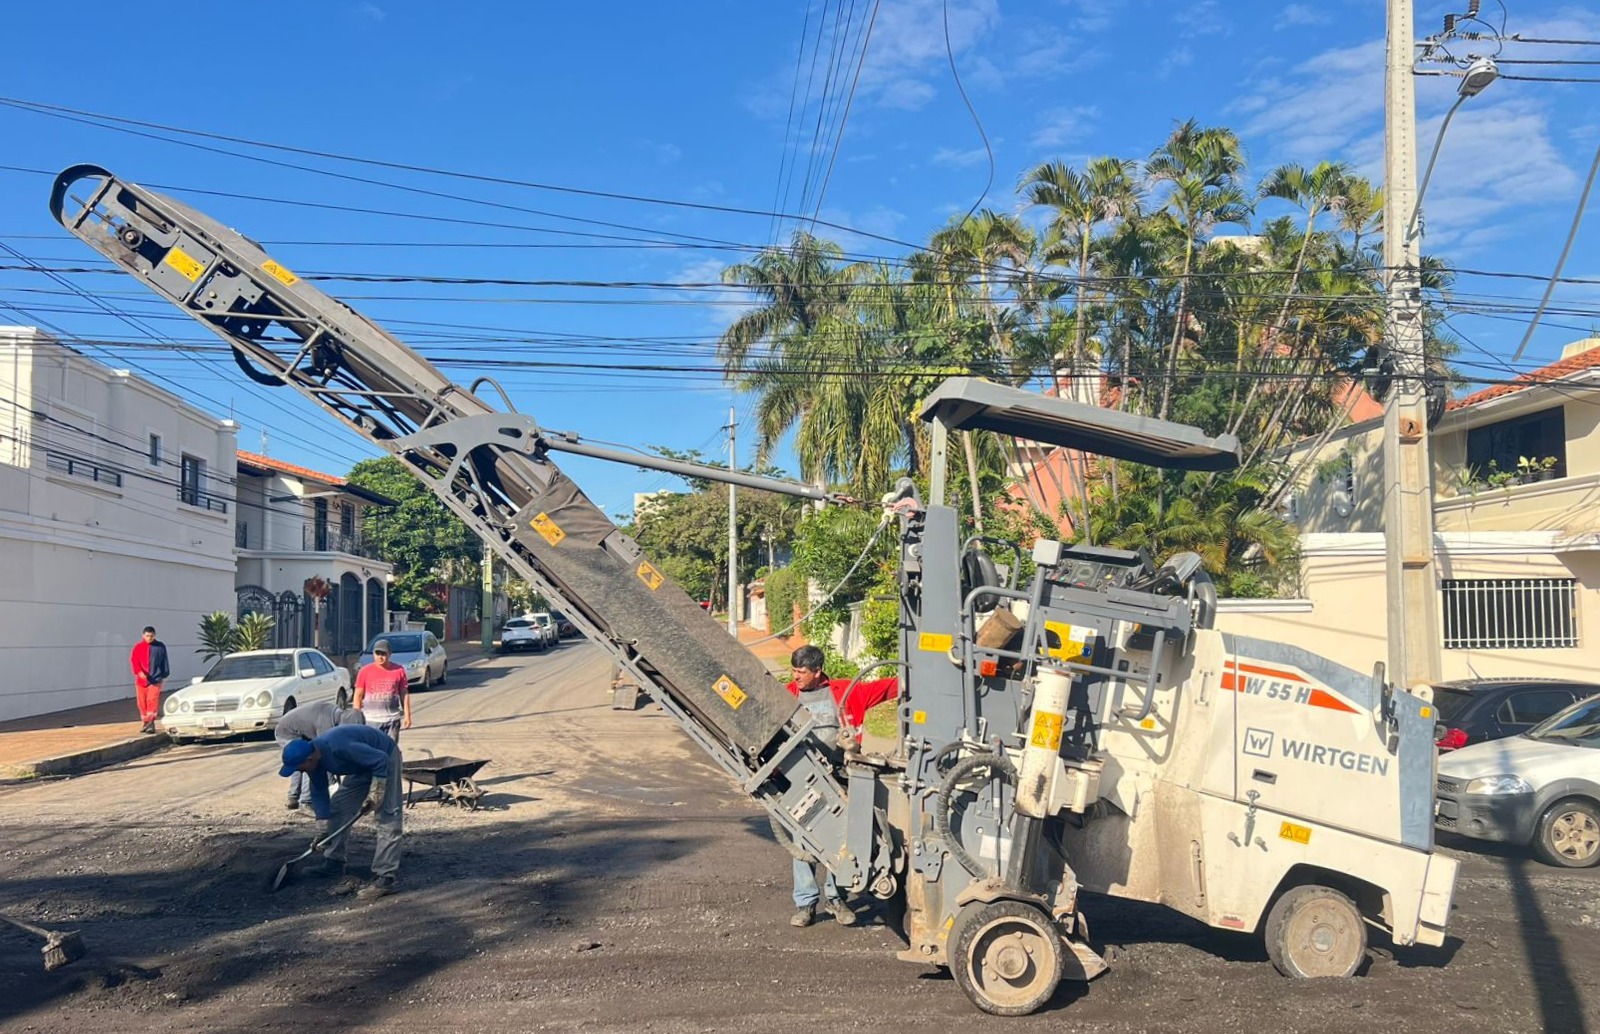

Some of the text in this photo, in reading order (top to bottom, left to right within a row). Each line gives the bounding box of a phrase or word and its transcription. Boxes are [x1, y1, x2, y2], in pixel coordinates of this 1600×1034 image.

[1245, 676, 1310, 704] W 55 H
[1282, 738, 1389, 777] WIRTGEN
